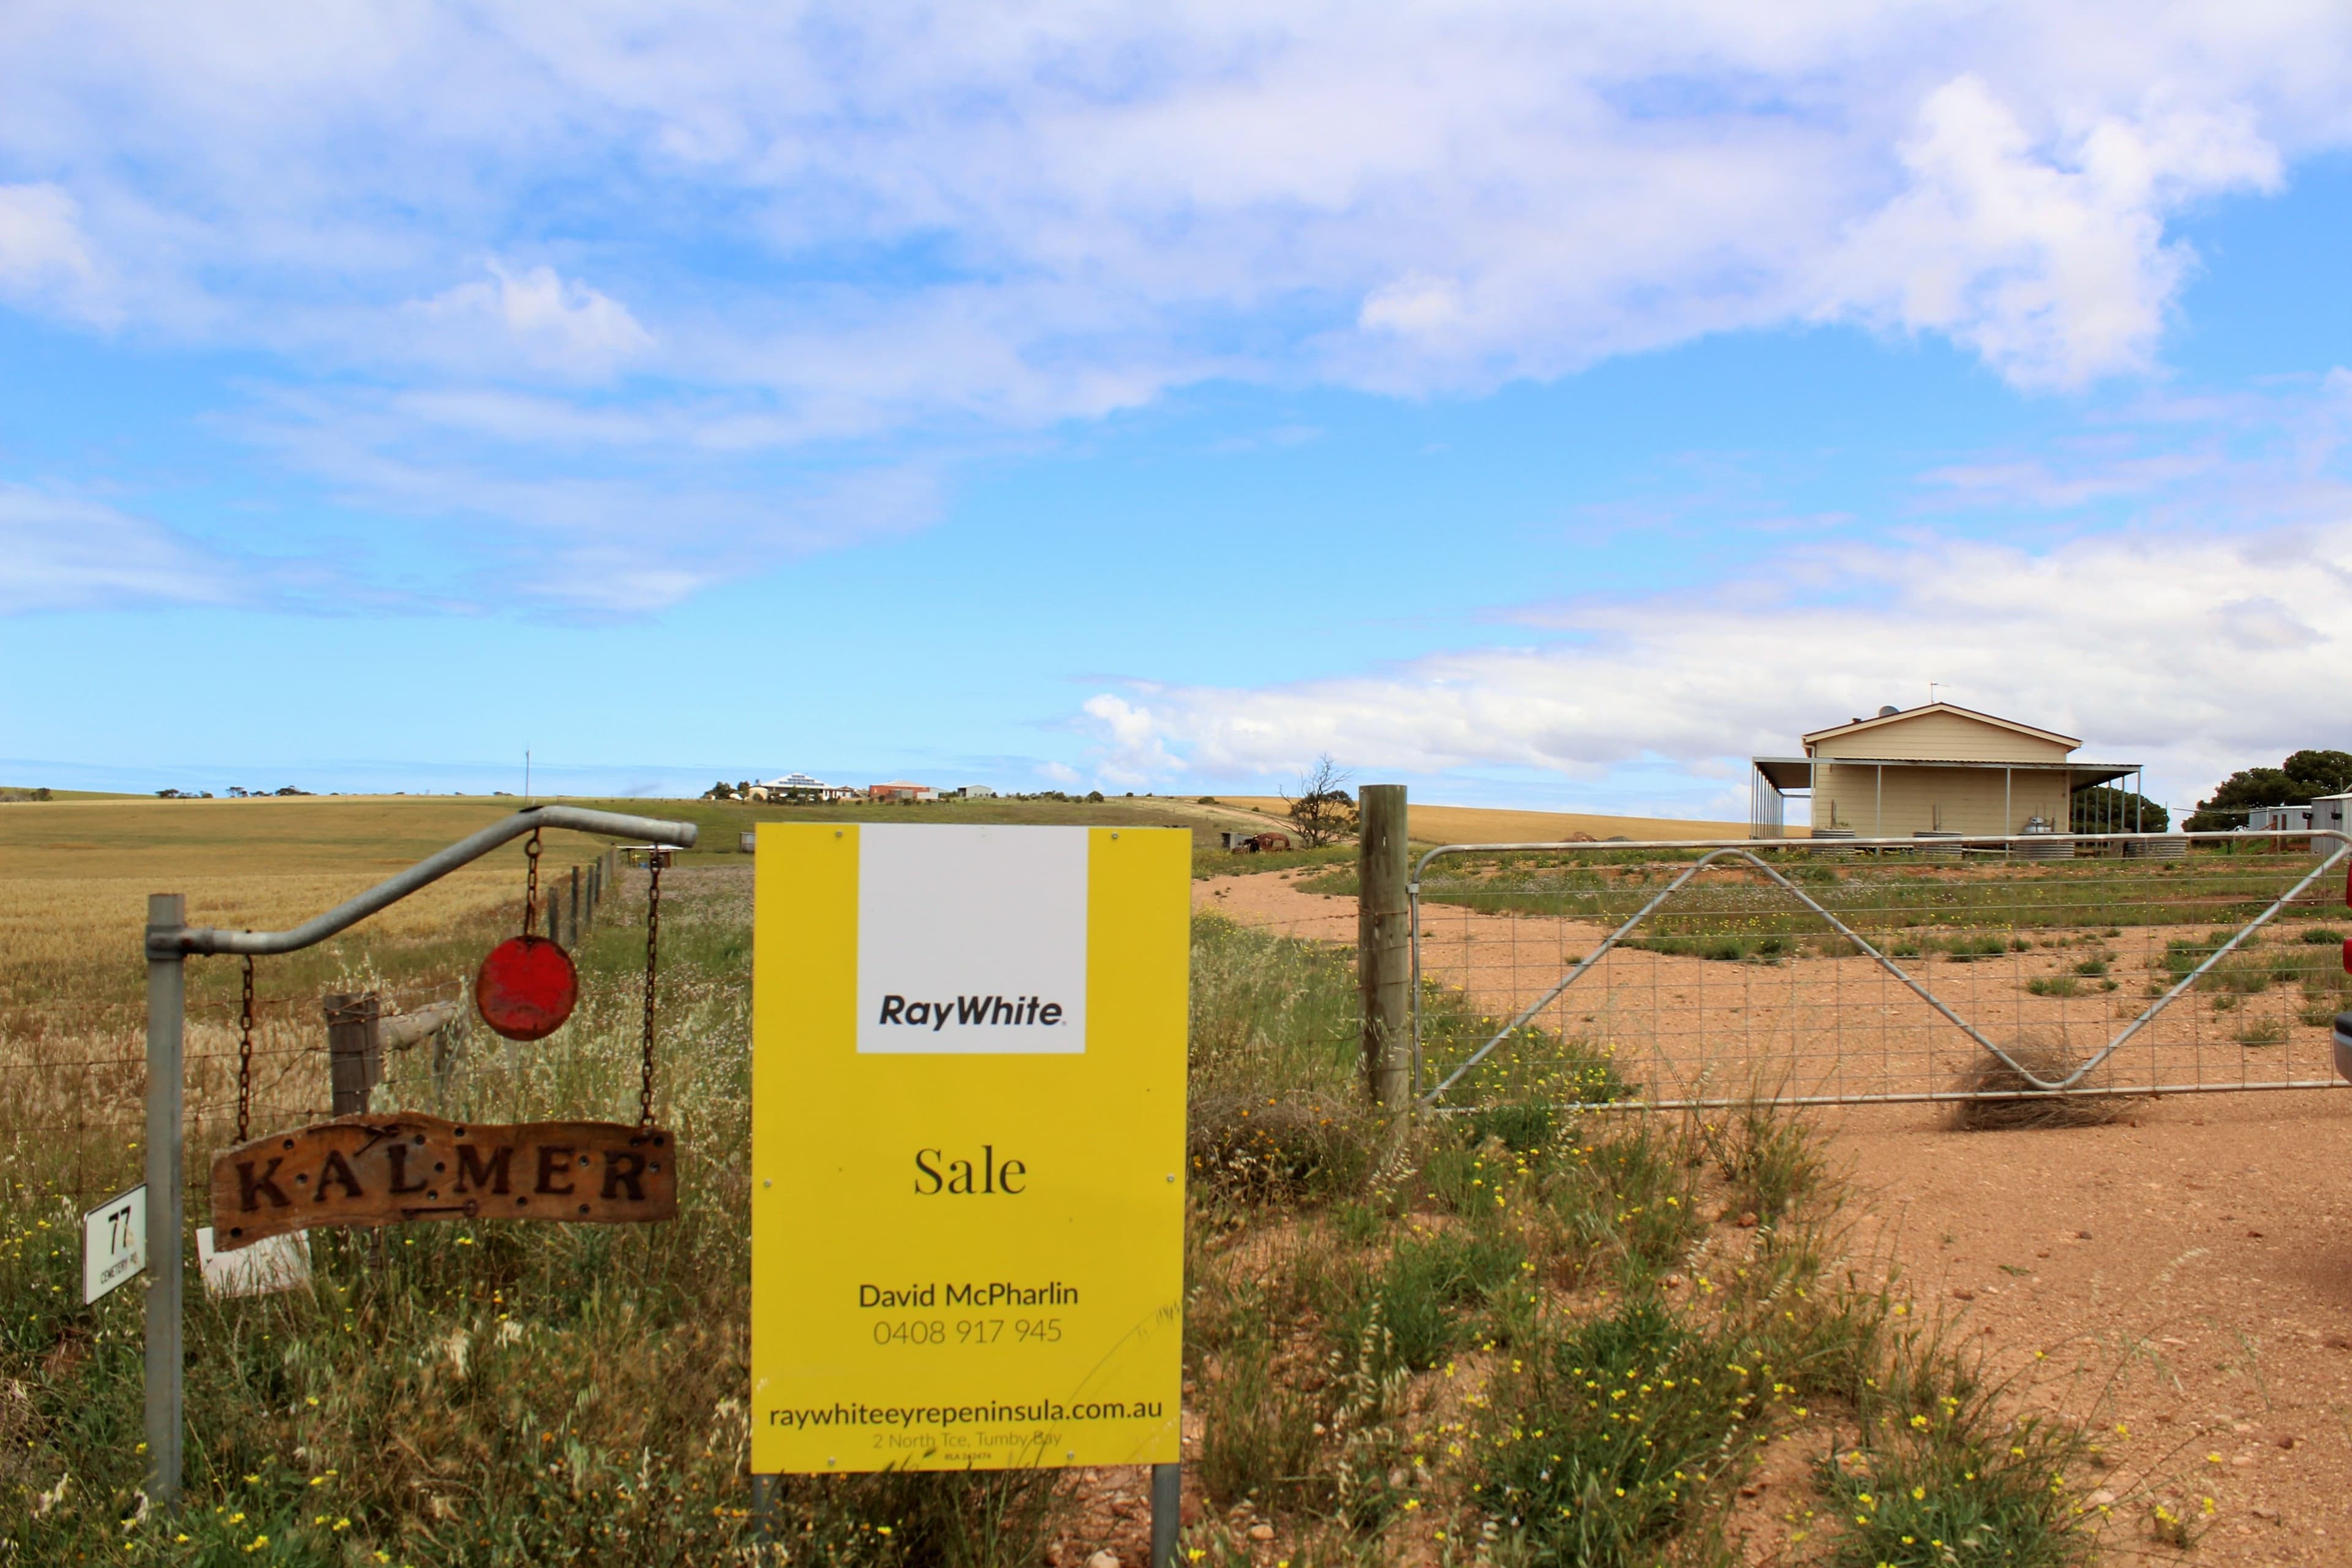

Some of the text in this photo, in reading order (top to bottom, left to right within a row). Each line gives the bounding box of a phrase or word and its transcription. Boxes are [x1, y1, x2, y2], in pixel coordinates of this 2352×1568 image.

[236, 1144, 646, 1212] KALMER
[914, 1145, 1027, 1195] Sale
[108, 1205, 130, 1255] 77
[859, 1281, 1079, 1308] David McPharlin
[873, 1319, 1062, 1344] 0408 917 945
[770, 1400, 1162, 1430] raywhiteeyrepeninsula.com.au
[873, 1430, 1062, 1449] 2 North Tce, Tumby Bay
